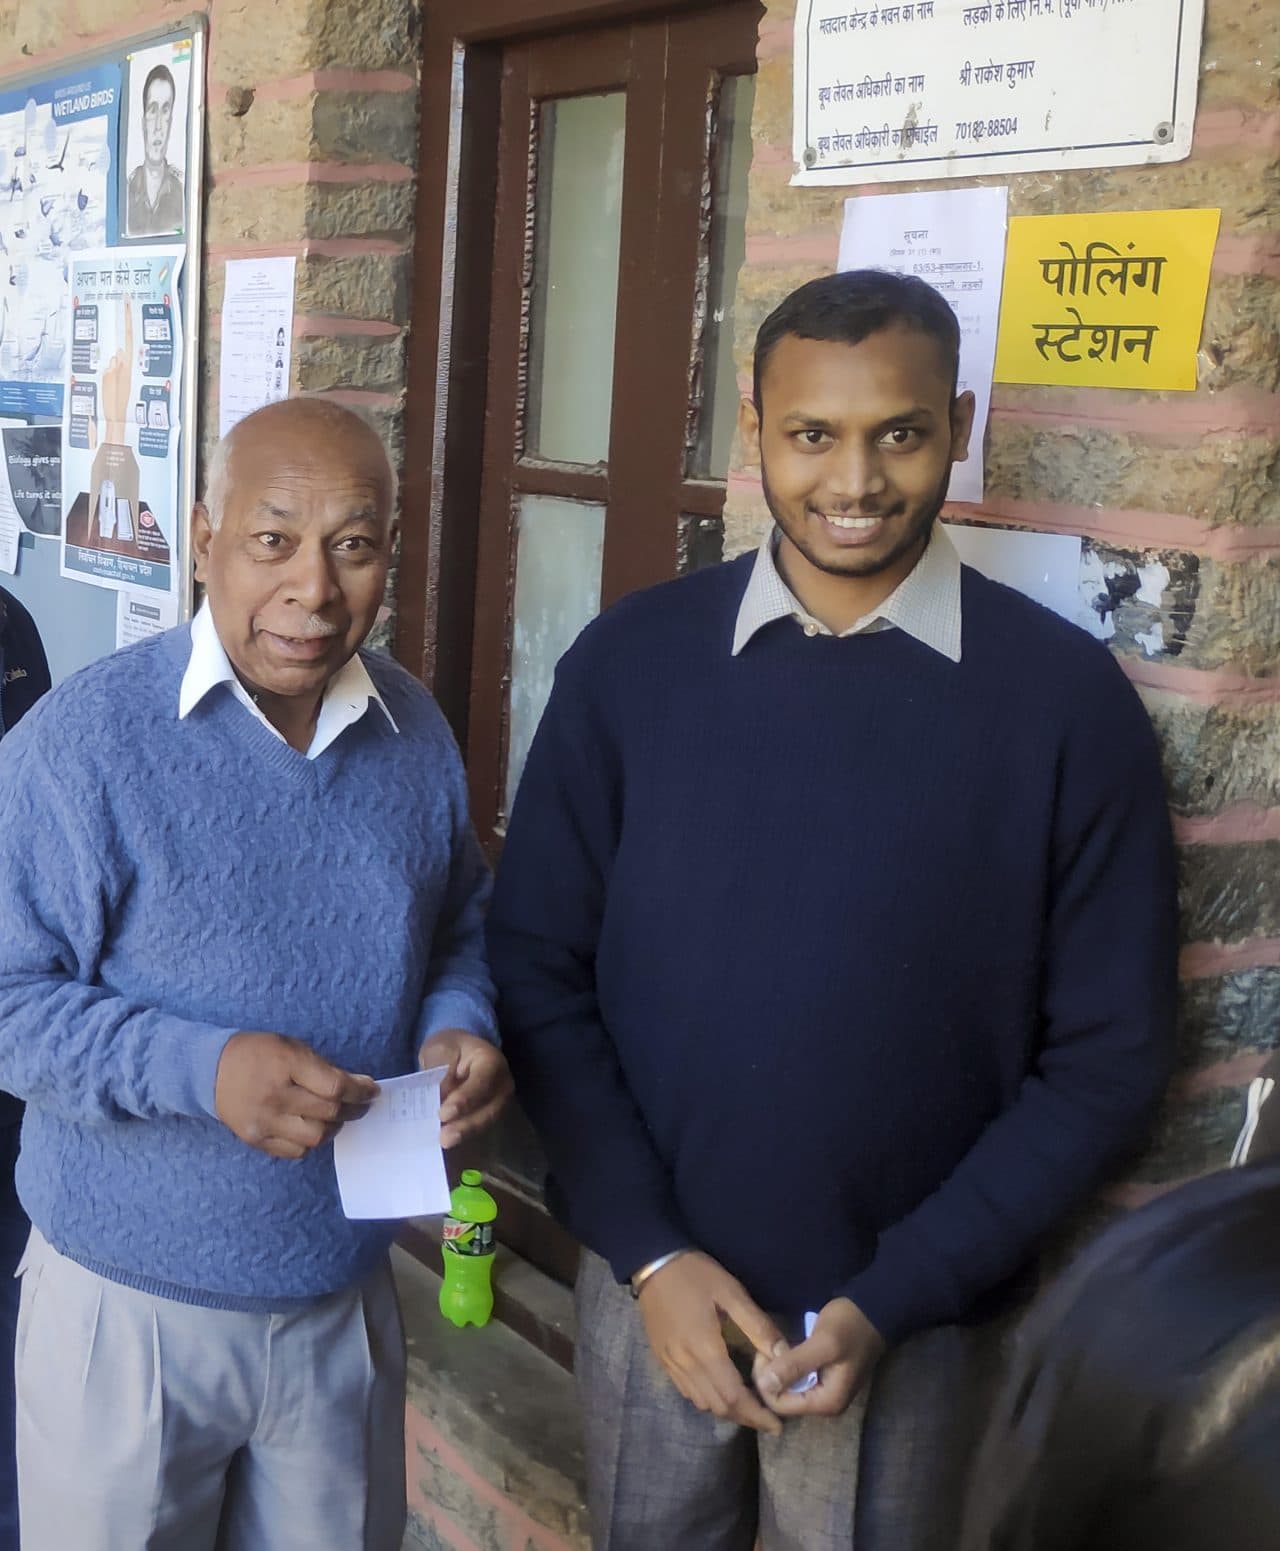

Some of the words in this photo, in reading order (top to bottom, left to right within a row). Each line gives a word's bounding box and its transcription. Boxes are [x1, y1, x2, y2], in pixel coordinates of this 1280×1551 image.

[849, 8, 867, 30] केन्द्र
[870, 3, 879, 27] के
[881, 7, 900, 25] भवन
[903, 4, 914, 21] का
[917, 1, 934, 19] नाम
[833, 79, 854, 102] लेवल
[856, 72, 892, 99] अधिकारी
[894, 77, 906, 95] का
[908, 75, 925, 92] नाम
[960, 60, 972, 86] श्री
[974, 58, 1004, 84] राकेश
[1006, 60, 1035, 89] कुमार
[54, 95, 90, 117] WETLAND
[91, 88, 114, 108] BIRDS
[832, 128, 852, 151] लेवल
[854, 123, 889, 149] अधिकारी
[904, 230, 929, 244] सूचना
[77, 271, 97, 287] अपना
[99, 270, 113, 286] मत
[1038, 241, 1168, 296] पोलिंग
[1032, 307, 1160, 364] स्टेशन
